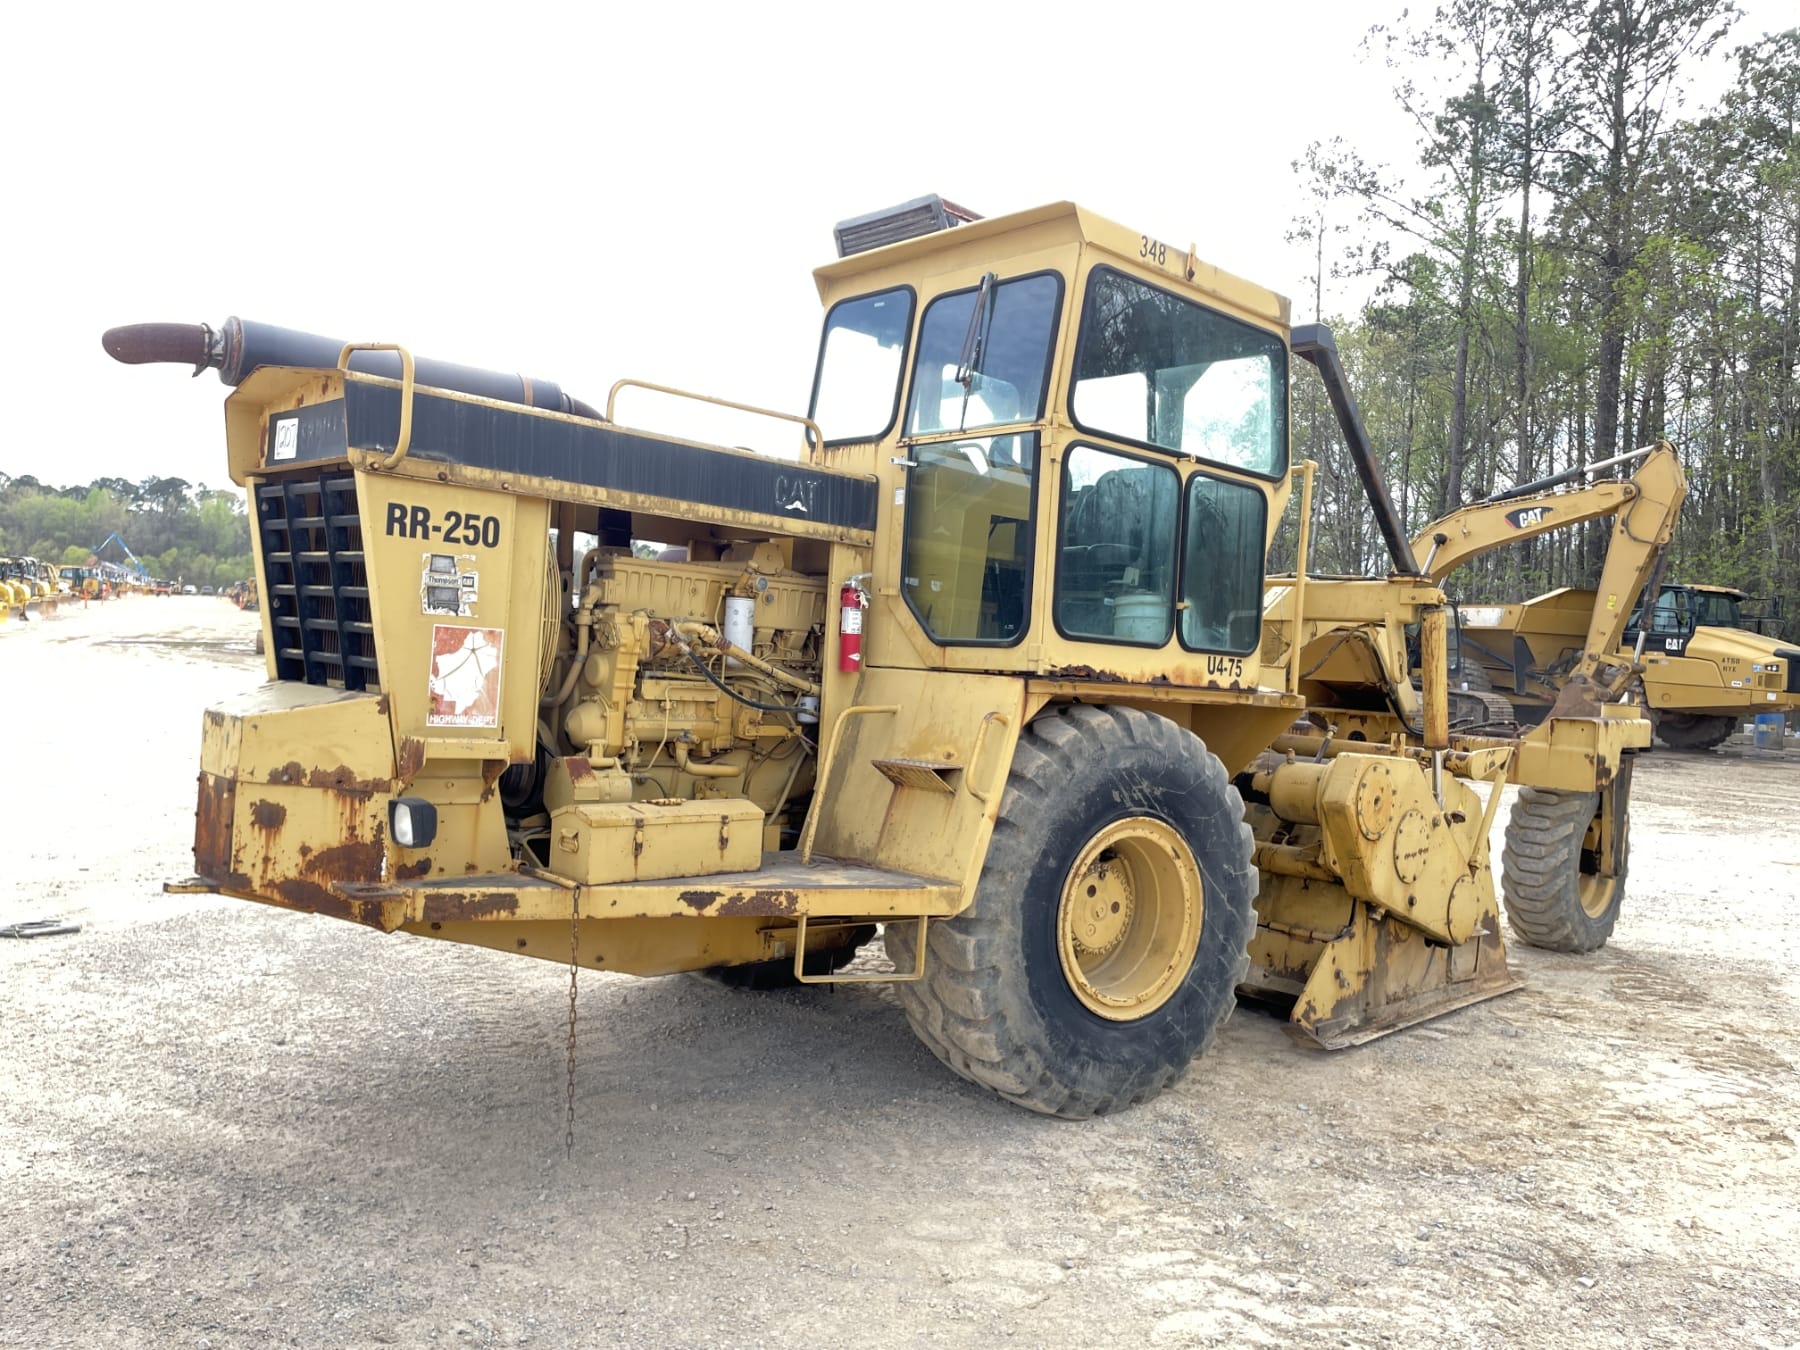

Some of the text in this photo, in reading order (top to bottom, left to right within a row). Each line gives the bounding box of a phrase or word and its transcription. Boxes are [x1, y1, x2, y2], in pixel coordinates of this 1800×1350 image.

[1140, 235, 1166, 265] 348
[775, 475, 820, 512] CAT
[386, 502, 500, 548] RR-250
[1519, 508, 1542, 528] CAT
[1665, 638, 1683, 650] CAT
[1208, 656, 1242, 677] U4-75
[429, 713, 468, 724] HIGHWAY
